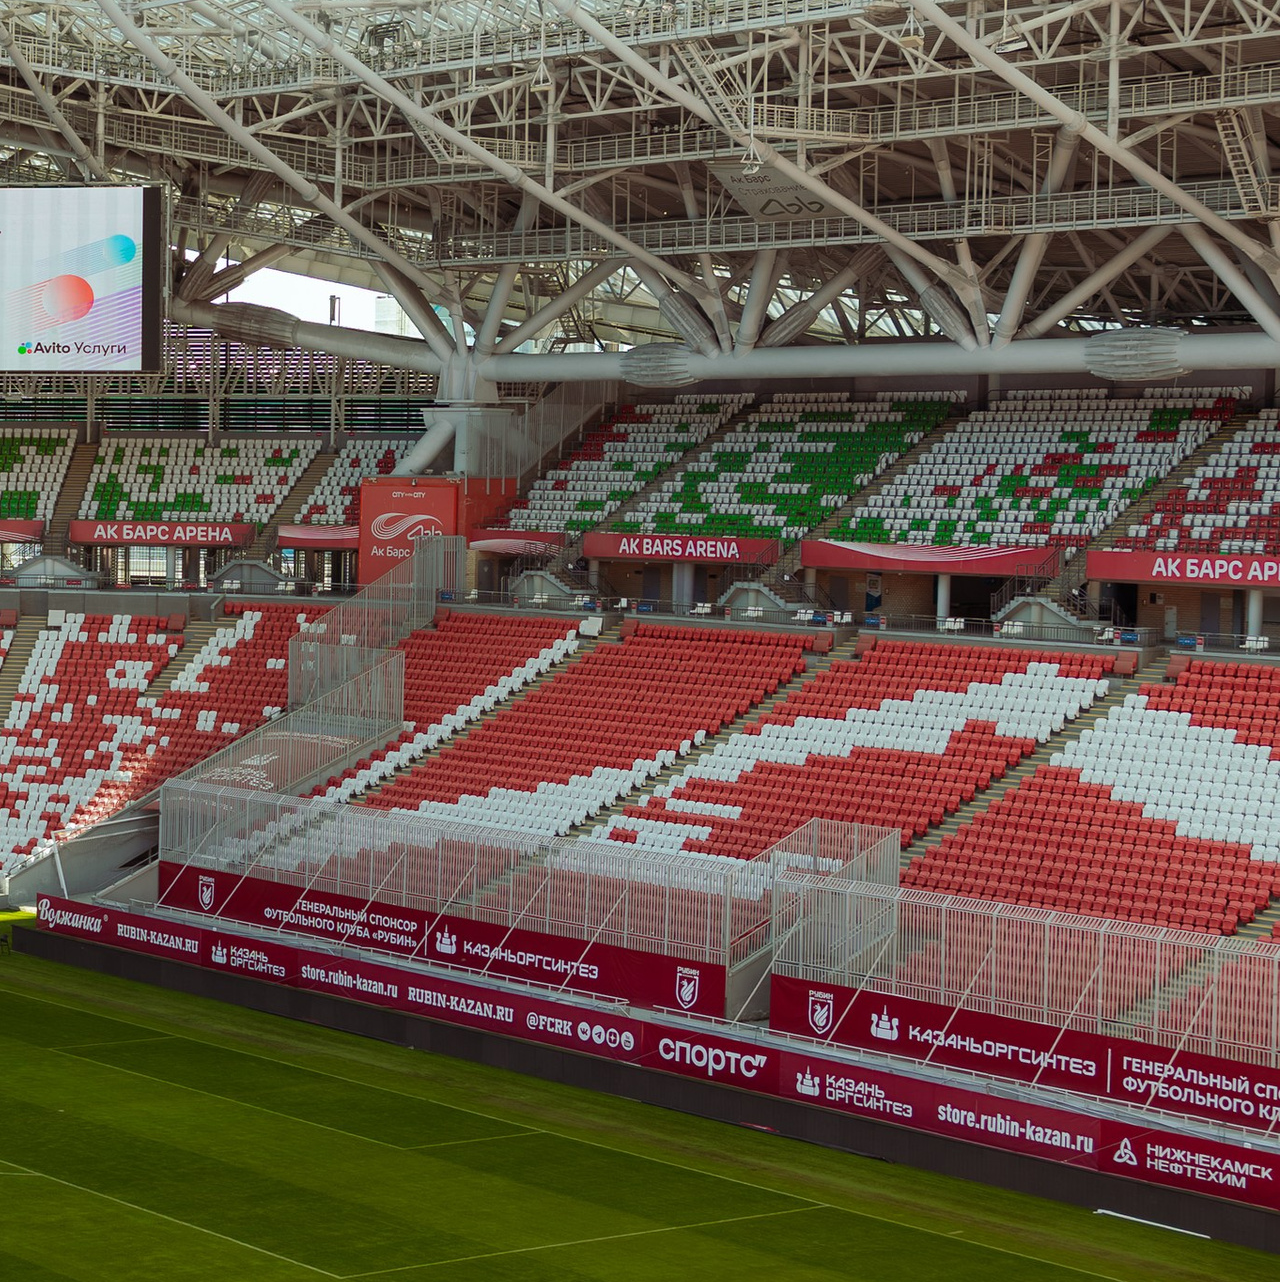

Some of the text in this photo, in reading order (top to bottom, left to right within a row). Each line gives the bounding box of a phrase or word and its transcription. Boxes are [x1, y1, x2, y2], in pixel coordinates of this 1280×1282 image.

[744, 175, 771, 184] Барс
[33, 341, 127, 356] Avito Услуги
[93, 524, 233, 542] АК БАРС АРЕНА
[619, 537, 740, 558] AK BARS ARENA
[371, 545, 410, 559] Ак Барс
[1152, 557, 1280, 581] АК БАРС АР
[264, 907, 417, 948] ФУТБОЛЬНОГО КЛУБА «РУБИН»
[296, 899, 418, 932] ГЕНЕРАЛЬНЫЙ СПОНСОР
[117, 923, 199, 954] RUBIN-KAZAN.RU
[230, 945, 269, 963] КАЗАНЬ
[230, 956, 286, 977] ОРГСИНТЕЗ
[463, 940, 599, 979] КАЗАНЬОРГСИНТЕЗ
[301, 963, 398, 999] store.rubin-kazan.ru
[407, 986, 514, 1023] RUBIN-KAZAN.RU
[526, 1012, 573, 1037] @FCRK
[909, 1025, 1096, 1077] КАЗАНЬОРГСИНТЕЗ
[826, 1074, 885, 1099] КАЗАНЬ
[1122, 1056, 1280, 1101] ГЕНЕРАЛЬНЫЙ СП
[826, 1087, 913, 1118] ОРГСИНТЕЗ
[1122, 1076, 1254, 1116] ФУТБОЛЬНОГО
[937, 1103, 1094, 1153] store.rubin-kazan.ru
[1146, 1143, 1273, 1181] НИЖНЕКАМСК
[1146, 1156, 1246, 1189] НЕФТЕХИМ
